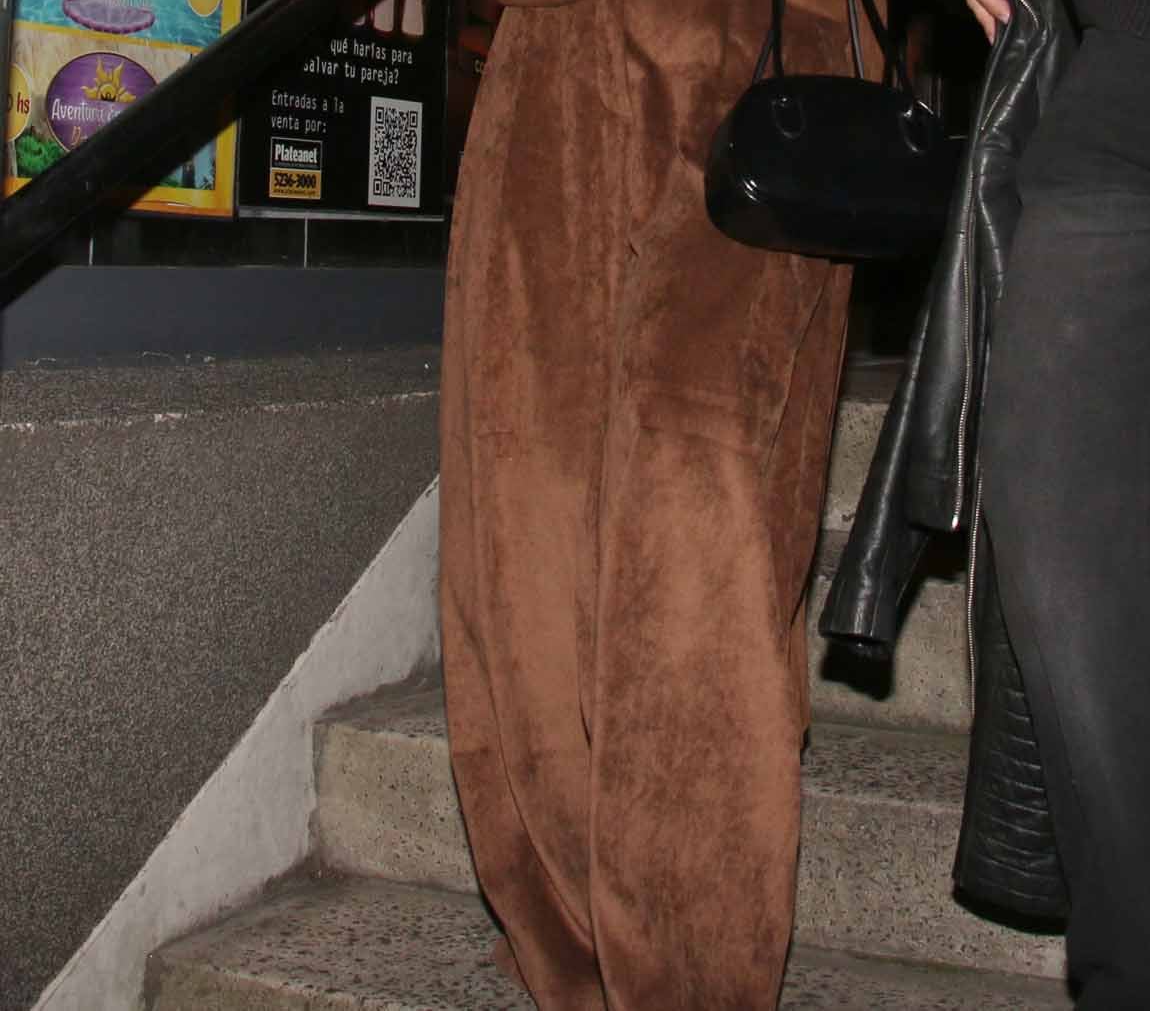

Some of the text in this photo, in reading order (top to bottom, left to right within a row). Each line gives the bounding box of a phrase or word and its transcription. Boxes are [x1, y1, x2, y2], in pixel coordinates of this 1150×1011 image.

[329, 37, 349, 57] qué
[391, 47, 414, 66] para
[344, 61, 356, 78] tu
[360, 66, 400, 87] pareja?
[271, 88, 345, 114] Entradas a la
[271, 114, 329, 135] venta por:
